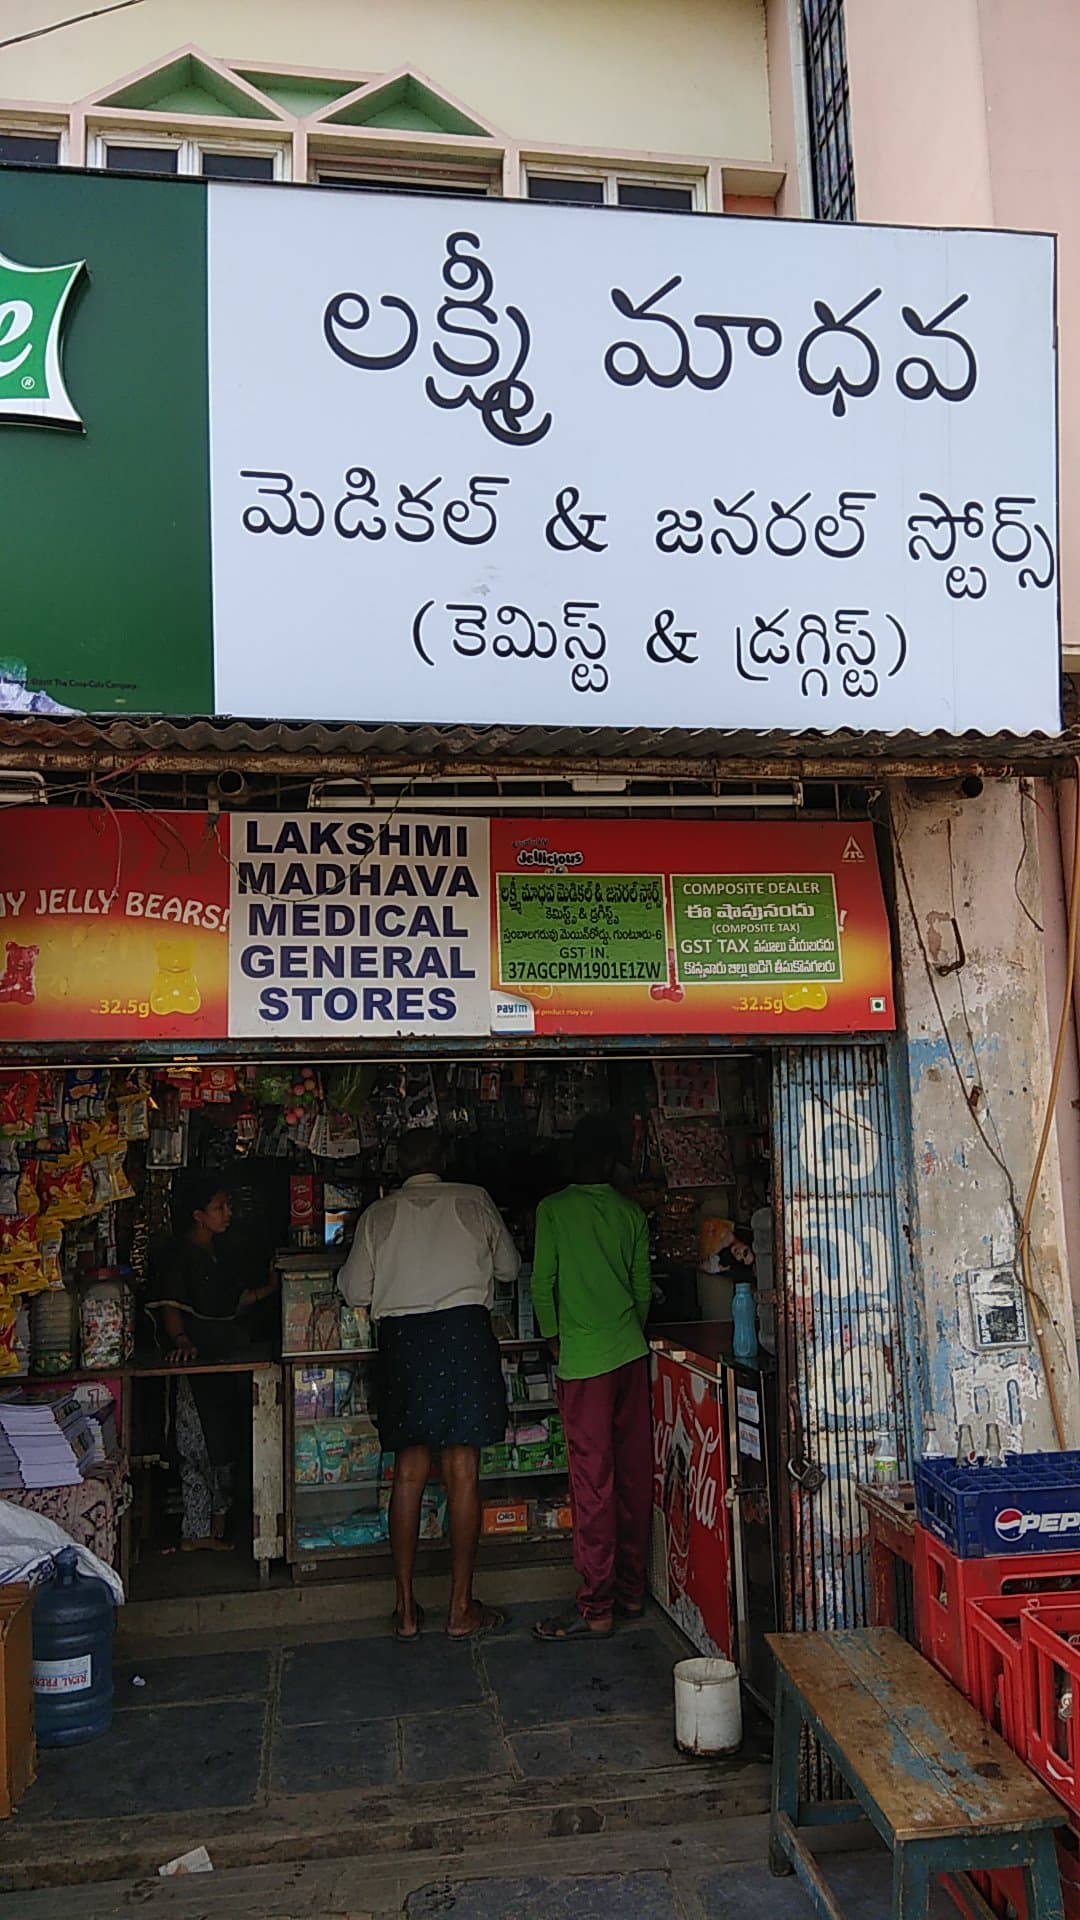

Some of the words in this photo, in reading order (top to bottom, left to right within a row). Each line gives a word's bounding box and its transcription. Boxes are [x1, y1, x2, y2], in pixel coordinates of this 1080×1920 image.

[323, 231, 552, 446] లక్ష్మీ
[605, 275, 977, 417] మాధవ
[240, 467, 510, 546] మెడికల్
[546, 487, 609, 553] &
[655, 490, 877, 559] జనరల్
[907, 492, 1055, 600] స్టోర్స్
[413, 600, 609, 693] (కెమిస్ట్
[646, 609, 699, 664] &
[736, 608, 908, 698] డ్రగ్గిస్ట్)
[246, 819, 469, 858] LAKSHMI
[518, 850, 583, 866] Jellicious
[237, 861, 479, 898] MADHAVA
[682, 882, 765, 895] COMPOSITE
[768, 882, 820, 894] DEALER
[521, 881, 555, 905] మాధవ
[556, 881, 594, 903] మెడికల్
[594, 883, 603, 902] &
[606, 881, 639, 903] జనరల్
[34, 888, 117, 916] JELLY
[125, 890, 230, 934] BEARS!
[248, 903, 469, 938] MEDICAL
[578, 907, 587, 920] &
[684, 903, 712, 919] ఈ
[716, 902, 815, 921] షాపునందు
[712, 923, 775, 935] (COMPOSITE
[778, 922, 800, 934] TAX)
[559, 947, 586, 959] GST
[591, 947, 609, 959] IN.
[681, 939, 712, 954] GST
[717, 939, 750, 953] TAX
[240, 944, 476, 979] GENERAL
[508, 961, 661, 980] 37AGCPM1901E1ZW
[99, 998, 151, 1018] 32.5g
[259, 987, 457, 1021] STORES
[738, 996, 784, 1015] 32.5g
[1018, 1511, 1080, 1534] PEP
[62, 1673, 87, 1687] REAL
